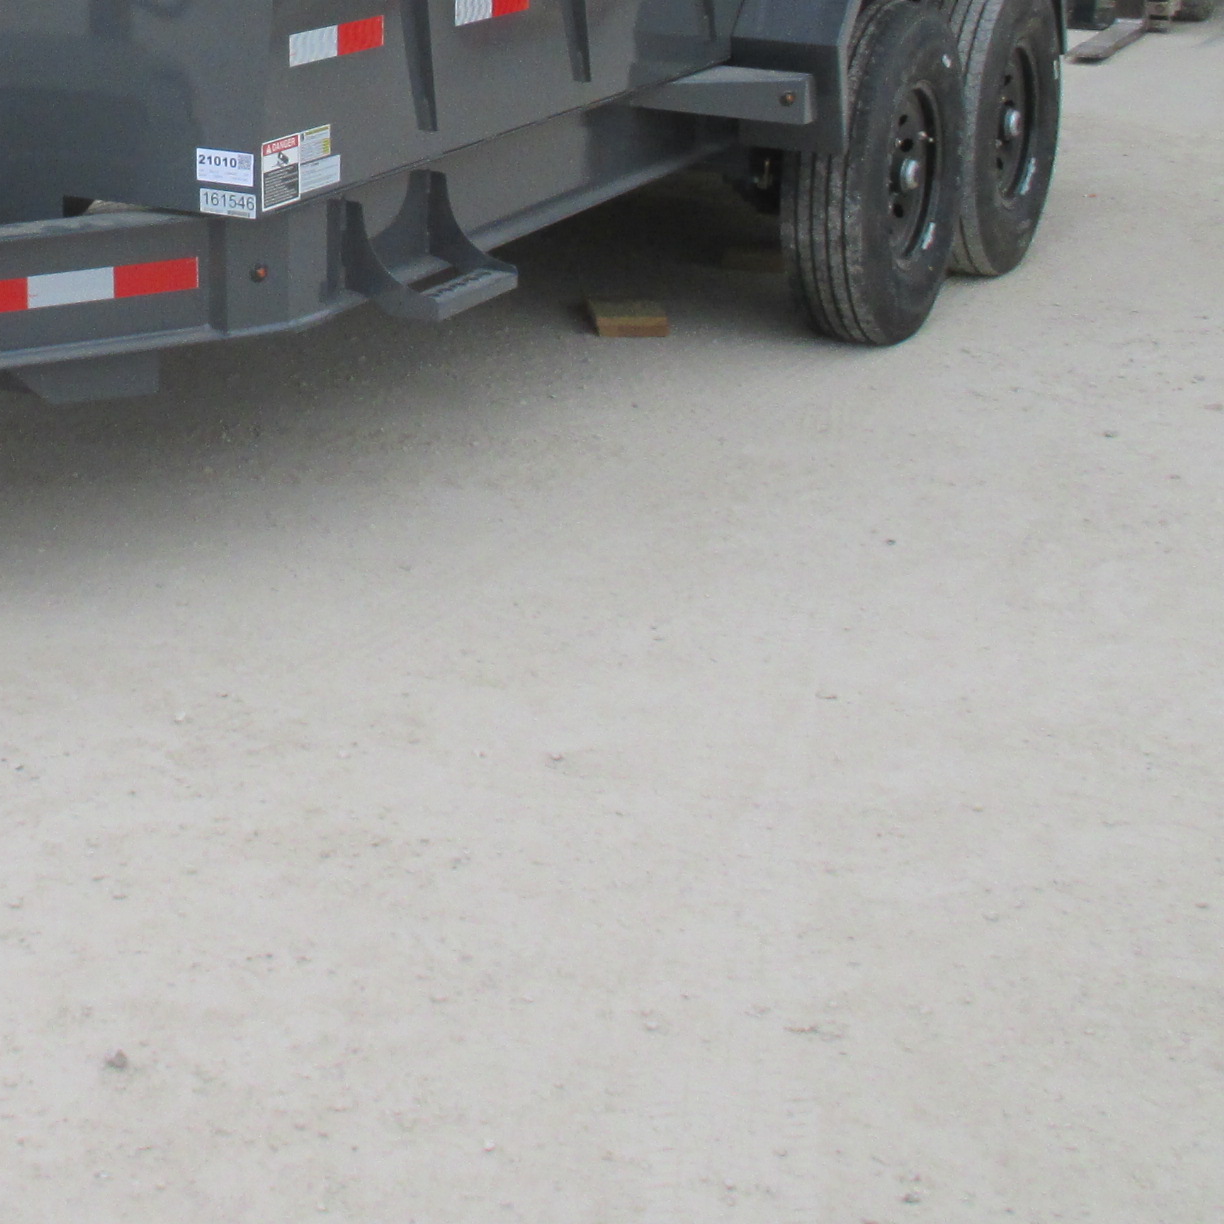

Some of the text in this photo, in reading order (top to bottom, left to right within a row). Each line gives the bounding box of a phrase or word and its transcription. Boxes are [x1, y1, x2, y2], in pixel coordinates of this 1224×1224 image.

[271, 137, 296, 152] DANGER
[198, 154, 237, 169] 21010
[203, 191, 255, 211] 161546
